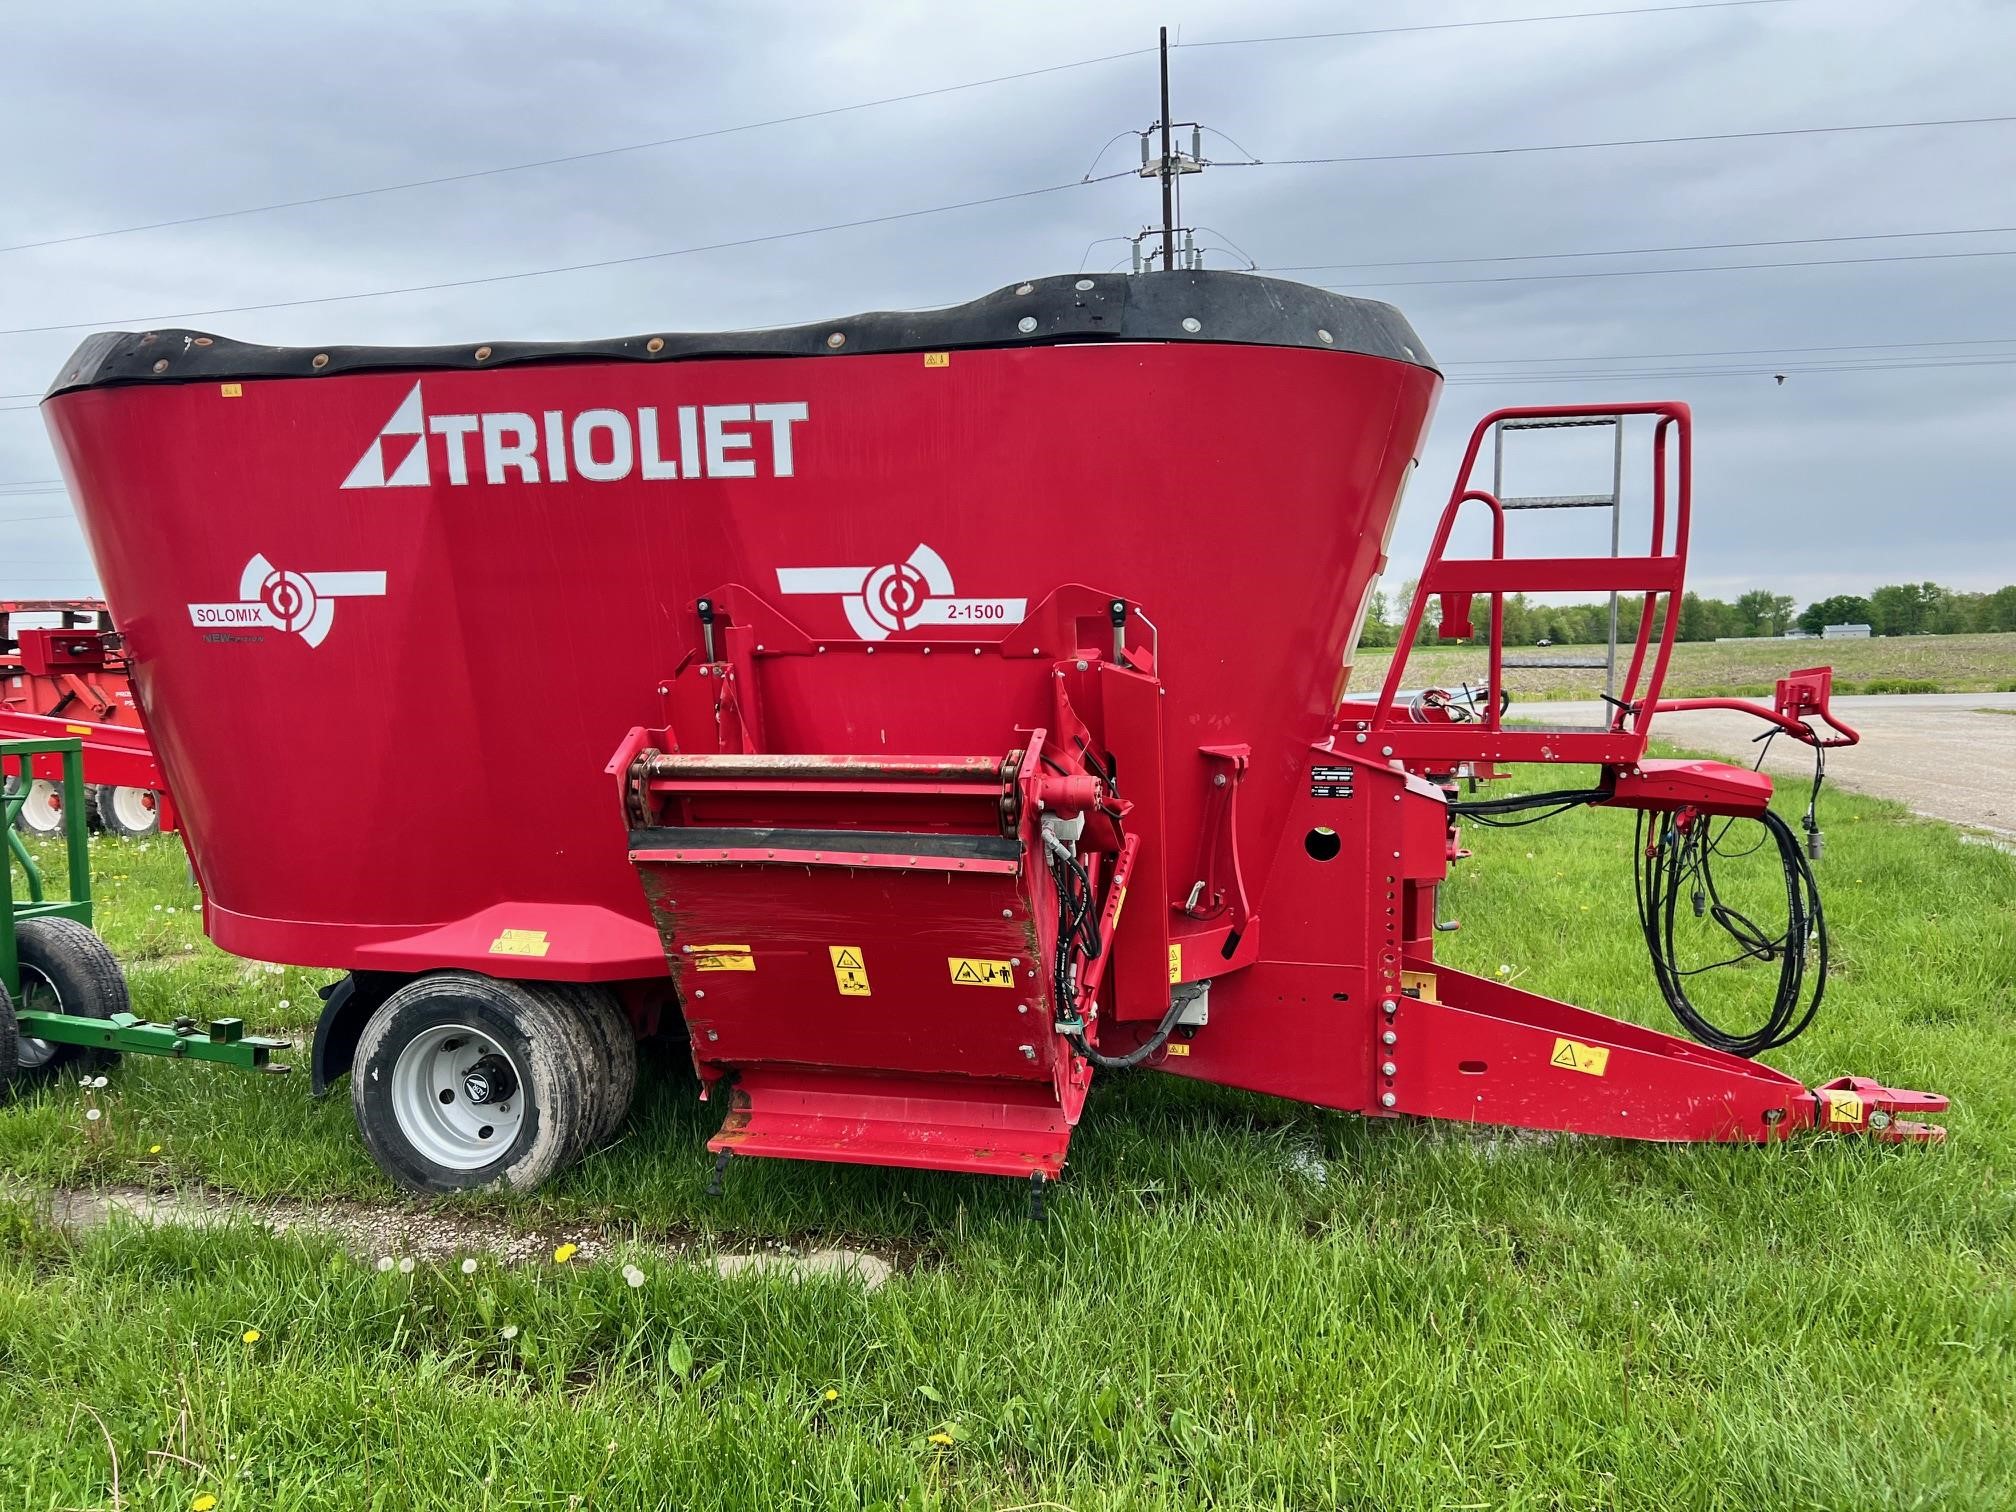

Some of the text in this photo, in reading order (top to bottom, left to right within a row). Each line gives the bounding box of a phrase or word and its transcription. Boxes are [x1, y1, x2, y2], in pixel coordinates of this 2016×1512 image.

[428, 401, 808, 486] TRIOLIET
[197, 608, 263, 622] SOLOMIX
[948, 604, 1004, 619] 2-1500
